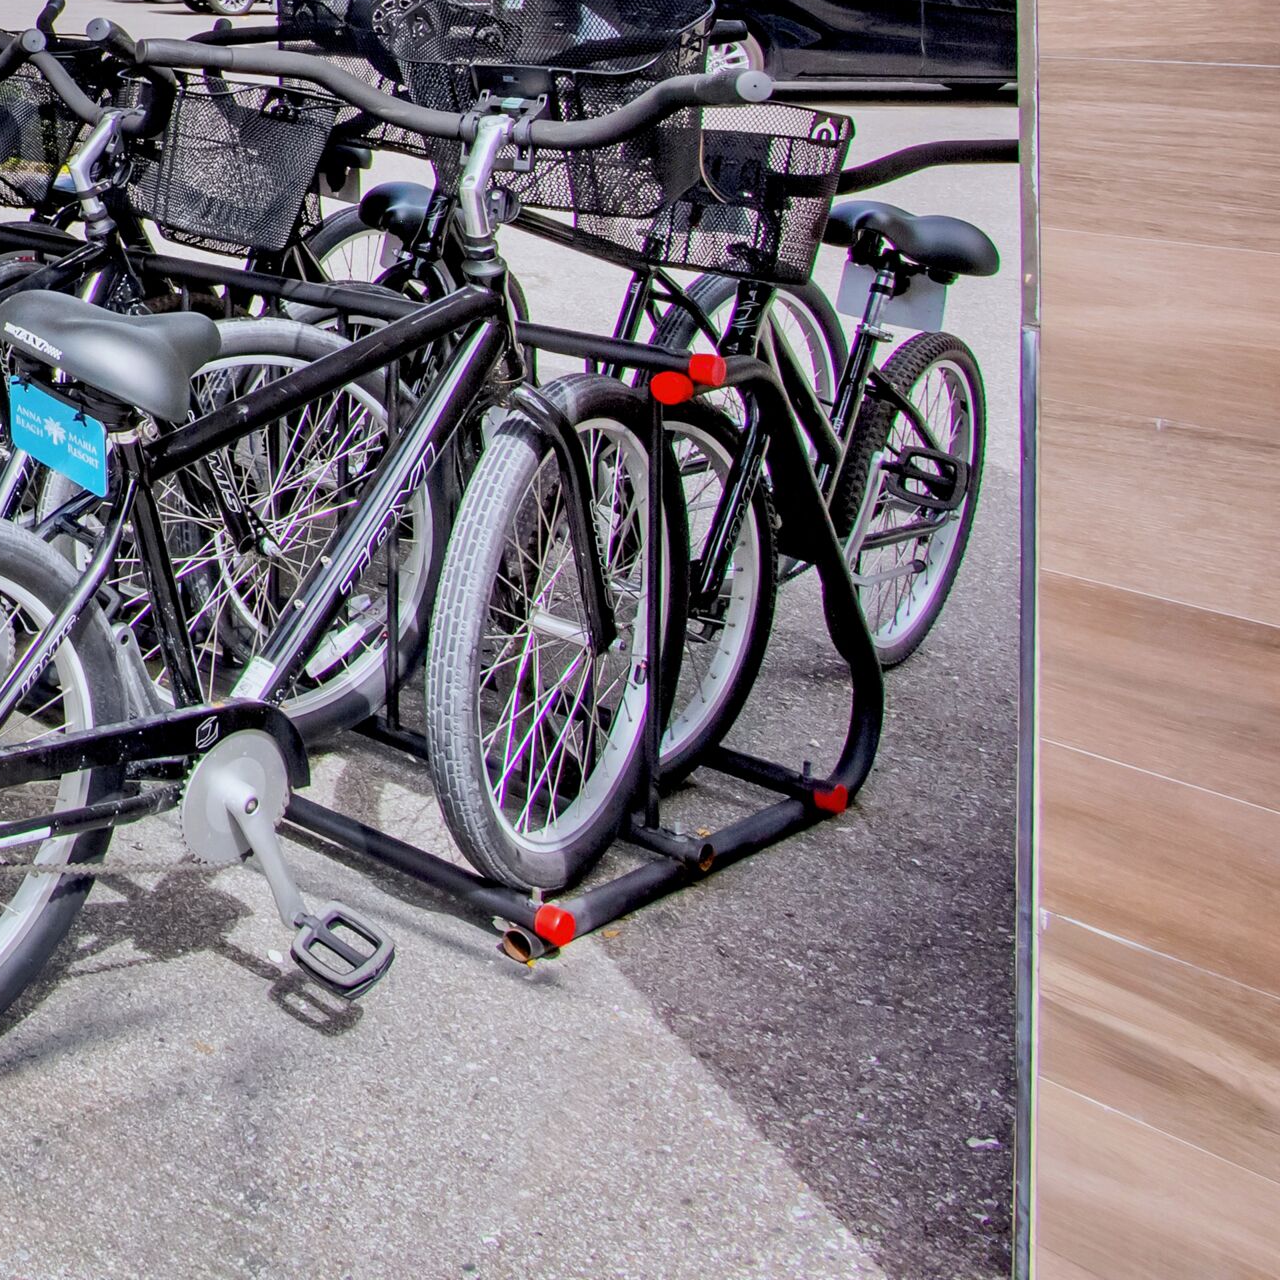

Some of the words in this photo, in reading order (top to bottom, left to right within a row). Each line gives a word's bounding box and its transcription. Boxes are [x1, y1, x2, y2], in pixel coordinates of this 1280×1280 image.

[16, 414, 44, 437] BEACH
[68, 443, 100, 469] RESORT
[17, 404, 42, 424] ANNA
[68, 432, 97, 455] MARIA
